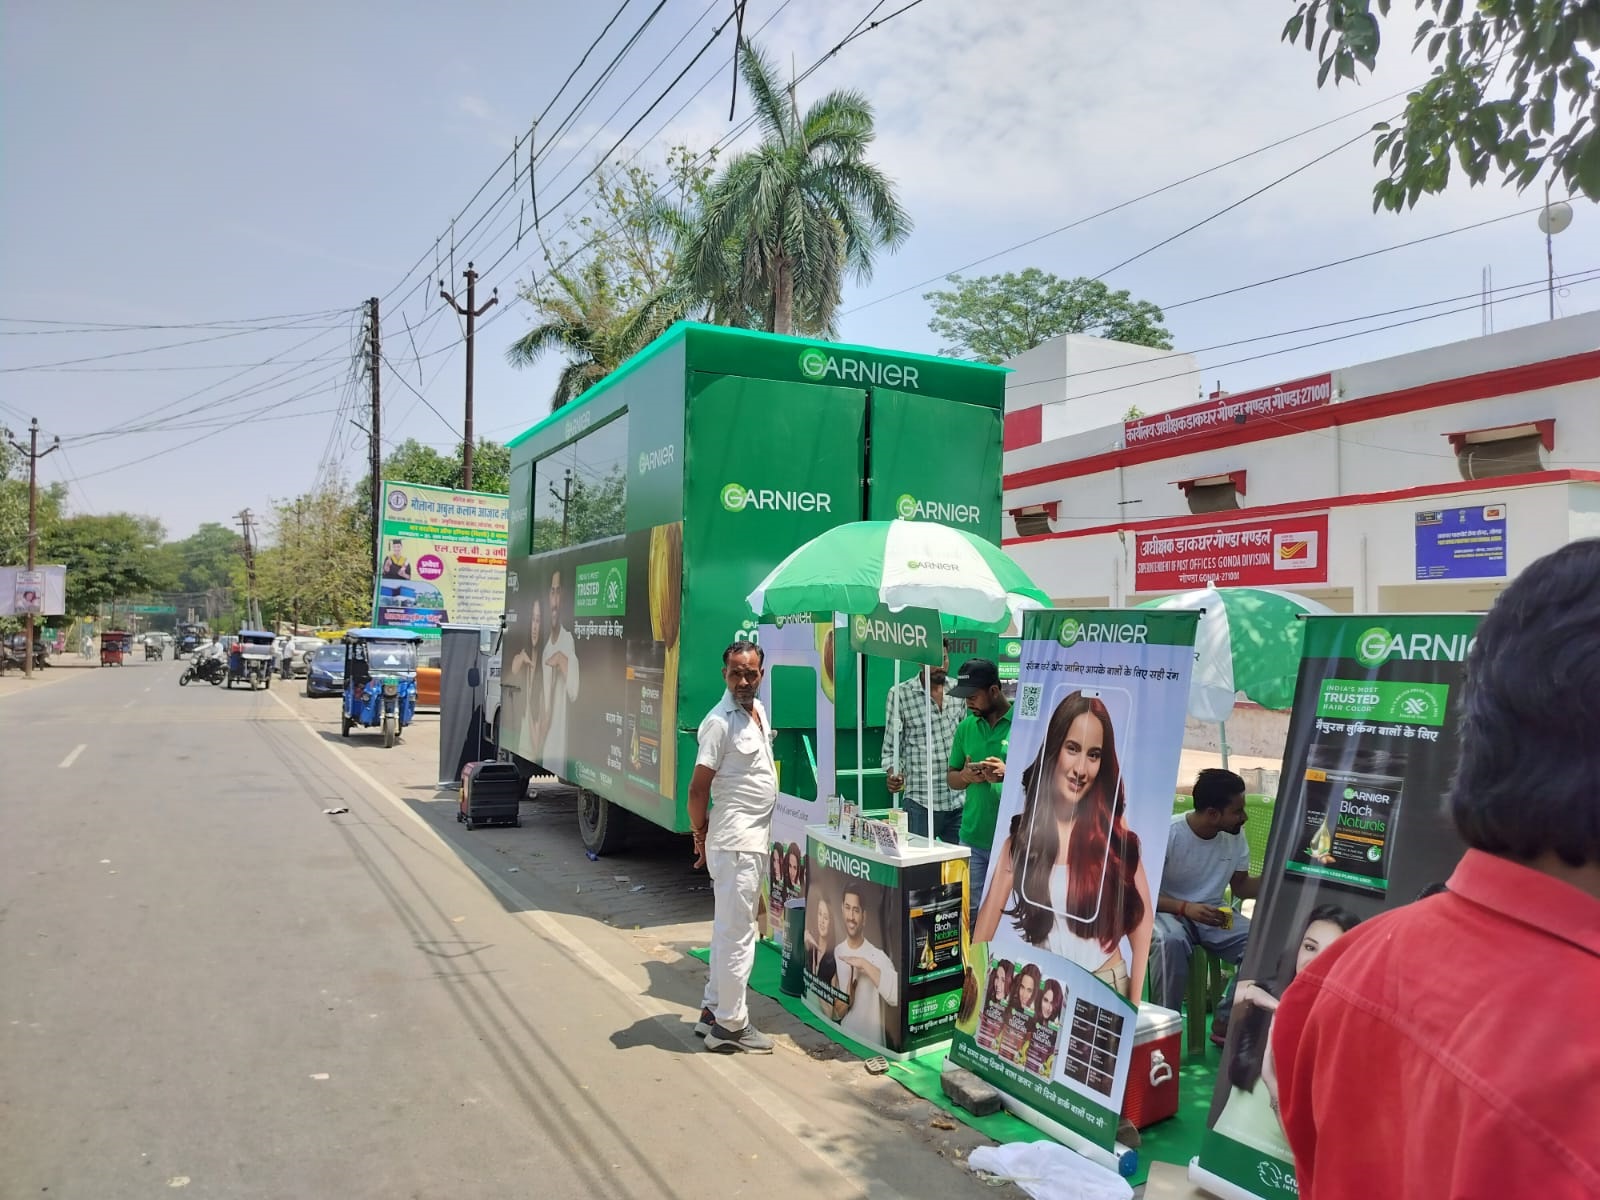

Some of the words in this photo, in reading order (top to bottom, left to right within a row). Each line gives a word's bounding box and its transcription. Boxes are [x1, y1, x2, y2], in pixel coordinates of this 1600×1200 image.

[803, 353, 919, 388] GARNIER
[1126, 420, 1155, 441] कार्यालय
[640, 444, 674, 474] GARNIER
[724, 489, 831, 512] GARNIER
[899, 498, 980, 523] GARNIER
[1141, 535, 1175, 559] अधीक्षक
[1175, 534, 1212, 554] डाकघर
[1212, 529, 1240, 549] गोण्डा
[1241, 528, 1272, 546] मण्डल
[908, 560, 960, 571] GARNIER
[1176, 559, 1188, 572] POST
[1189, 556, 1217, 570] OFFICES
[1217, 554, 1241, 569] GONDA
[1241, 552, 1271, 567] DIVISION
[577, 581, 600, 596] TRUSTED
[855, 619, 928, 648] GARNIER
[1062, 623, 1148, 644] GARNIER
[1361, 633, 1478, 662] GARNI
[1064, 662, 1085, 675] जानिए
[1124, 665, 1132, 676] के
[1134, 666, 1149, 680] लिए
[1149, 668, 1165, 681] सही
[1166, 668, 1179, 681] रंग
[1322, 704, 1344, 712] HAIR
[1323, 692, 1380, 705] TRUSTED
[1315, 718, 1345, 734] नैचुरल
[1346, 720, 1376, 736] लुकिंग
[1378, 724, 1402, 737] बालों
[1403, 725, 1417, 738] के
[1417, 727, 1440, 742] लिए
[1345, 789, 1391, 804] GARNIER
[1339, 800, 1373, 817] Black
[1337, 813, 1386, 833] Naturals
[818, 844, 870, 880] GARNIER
[934, 920, 951, 932] Black
[912, 1003, 938, 1016] TRUSTED
[1070, 1103, 1086, 1118] बालों
[1086, 1112, 1096, 1125] पर
